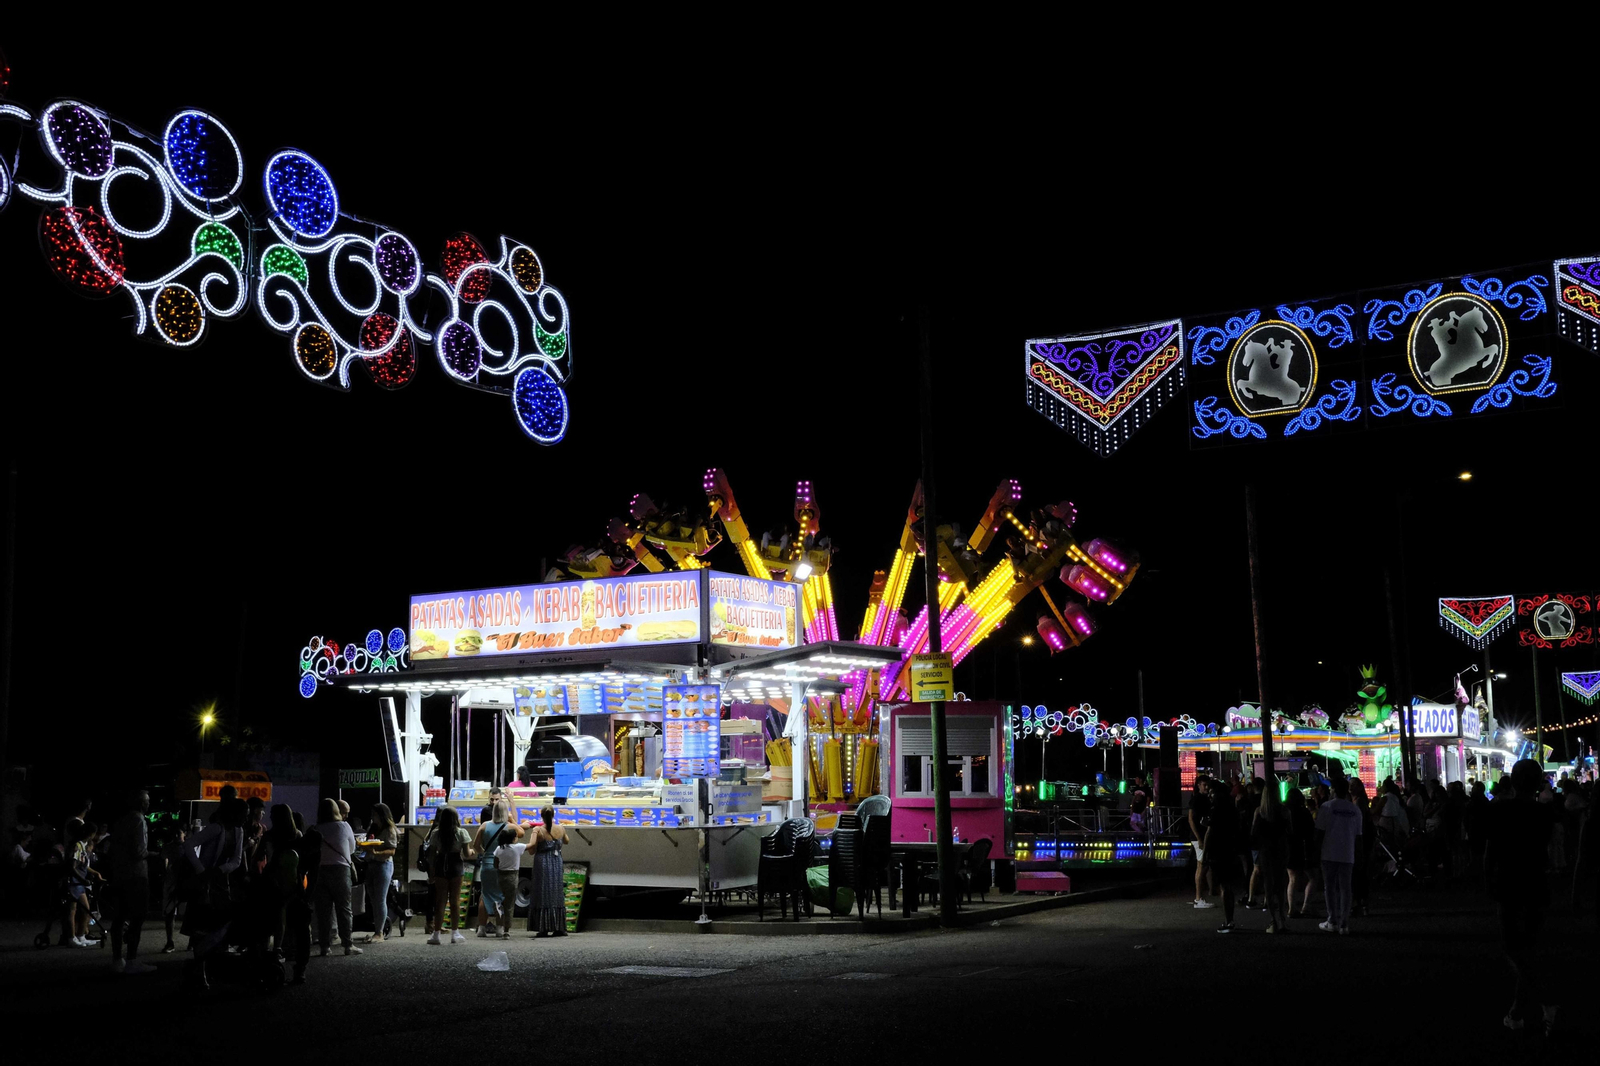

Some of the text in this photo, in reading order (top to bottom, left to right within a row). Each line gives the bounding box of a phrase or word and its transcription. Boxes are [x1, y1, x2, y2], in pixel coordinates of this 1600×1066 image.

[711, 578, 796, 607] PATATAS ASADAS KEBAB
[411, 580, 699, 630] PATATAS ASADAS KEBAB BAGUETTERIA
[727, 606, 783, 629] BAGUETTERIA
[518, 631, 564, 650] Buen
[339, 770, 379, 788] TAQUILLA
